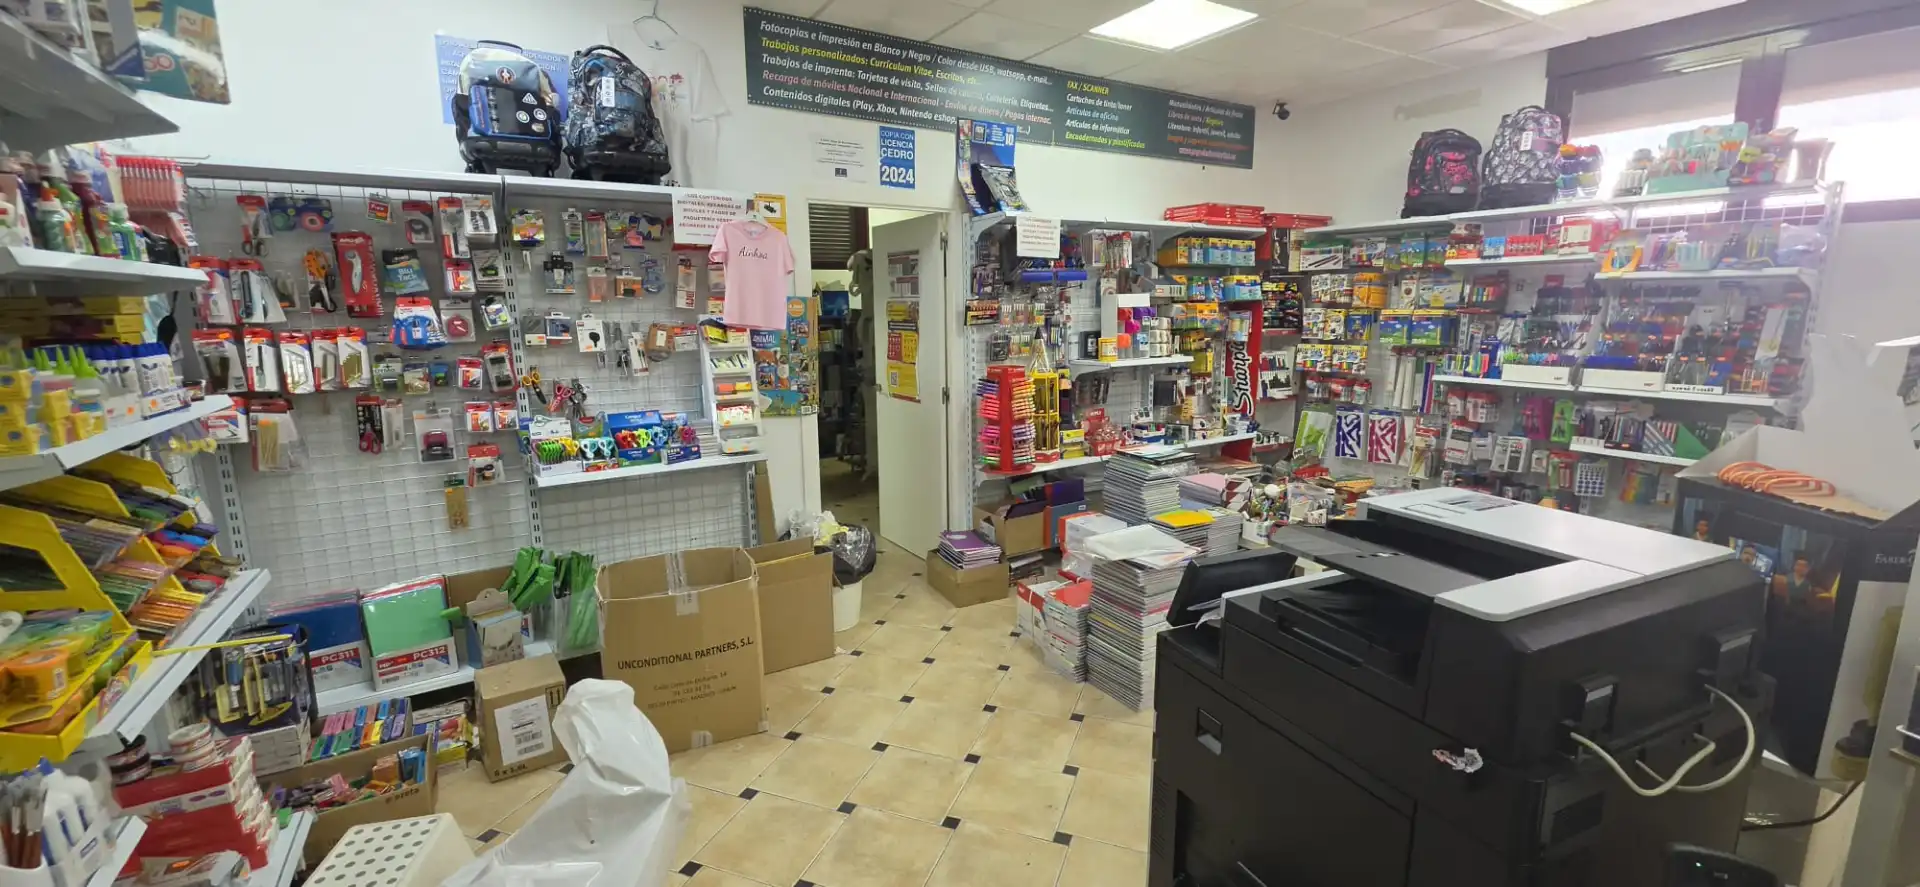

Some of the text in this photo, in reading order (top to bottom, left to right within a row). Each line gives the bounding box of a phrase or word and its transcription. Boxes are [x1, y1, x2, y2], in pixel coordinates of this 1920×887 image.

[761, 20, 809, 39] Fotocopias
[811, 32, 816, 40] e
[862, 42, 872, 50] en
[874, 43, 900, 56] Blanco
[901, 50, 907, 59] y
[909, 50, 931, 66] Negro
[937, 55, 957, 68] Color
[761, 37, 800, 53] Trabajos
[801, 46, 868, 65] personalizados:
[913, 65, 934, 78] Vitae,
[762, 54, 800, 70] Trabajos
[801, 62, 813, 71] de
[815, 61, 856, 80] imprenta:
[858, 70, 889, 85] Tarjetas
[889, 77, 900, 87] de
[901, 78, 923, 91] visita,
[1067, 81, 1077, 89] FAX
[763, 70, 799, 86] Recarga
[801, 77, 812, 87] de
[814, 78, 846, 92] móviles
[848, 85, 882, 98] Nacional
[890, 90, 939, 107] Internacional
[763, 86, 813, 102] Contenidos
[815, 93, 850, 108] digitales
[852, 99, 875, 113] (Play,
[876, 104, 898, 116] Xbox,
[900, 106, 933, 119] Nintendo
[880, 130, 914, 141] COPIA CON
[881, 139, 914, 149] LICENCIA
[881, 148, 914, 160] CEDRO
[881, 165, 915, 184] 2024
[1231, 340, 1254, 416] Sharpi
[321, 650, 355, 664] PC311
[413, 646, 446, 660] PC312
[617, 636, 754, 670] UNCONDITIONAL PARTNERS, S.L.
